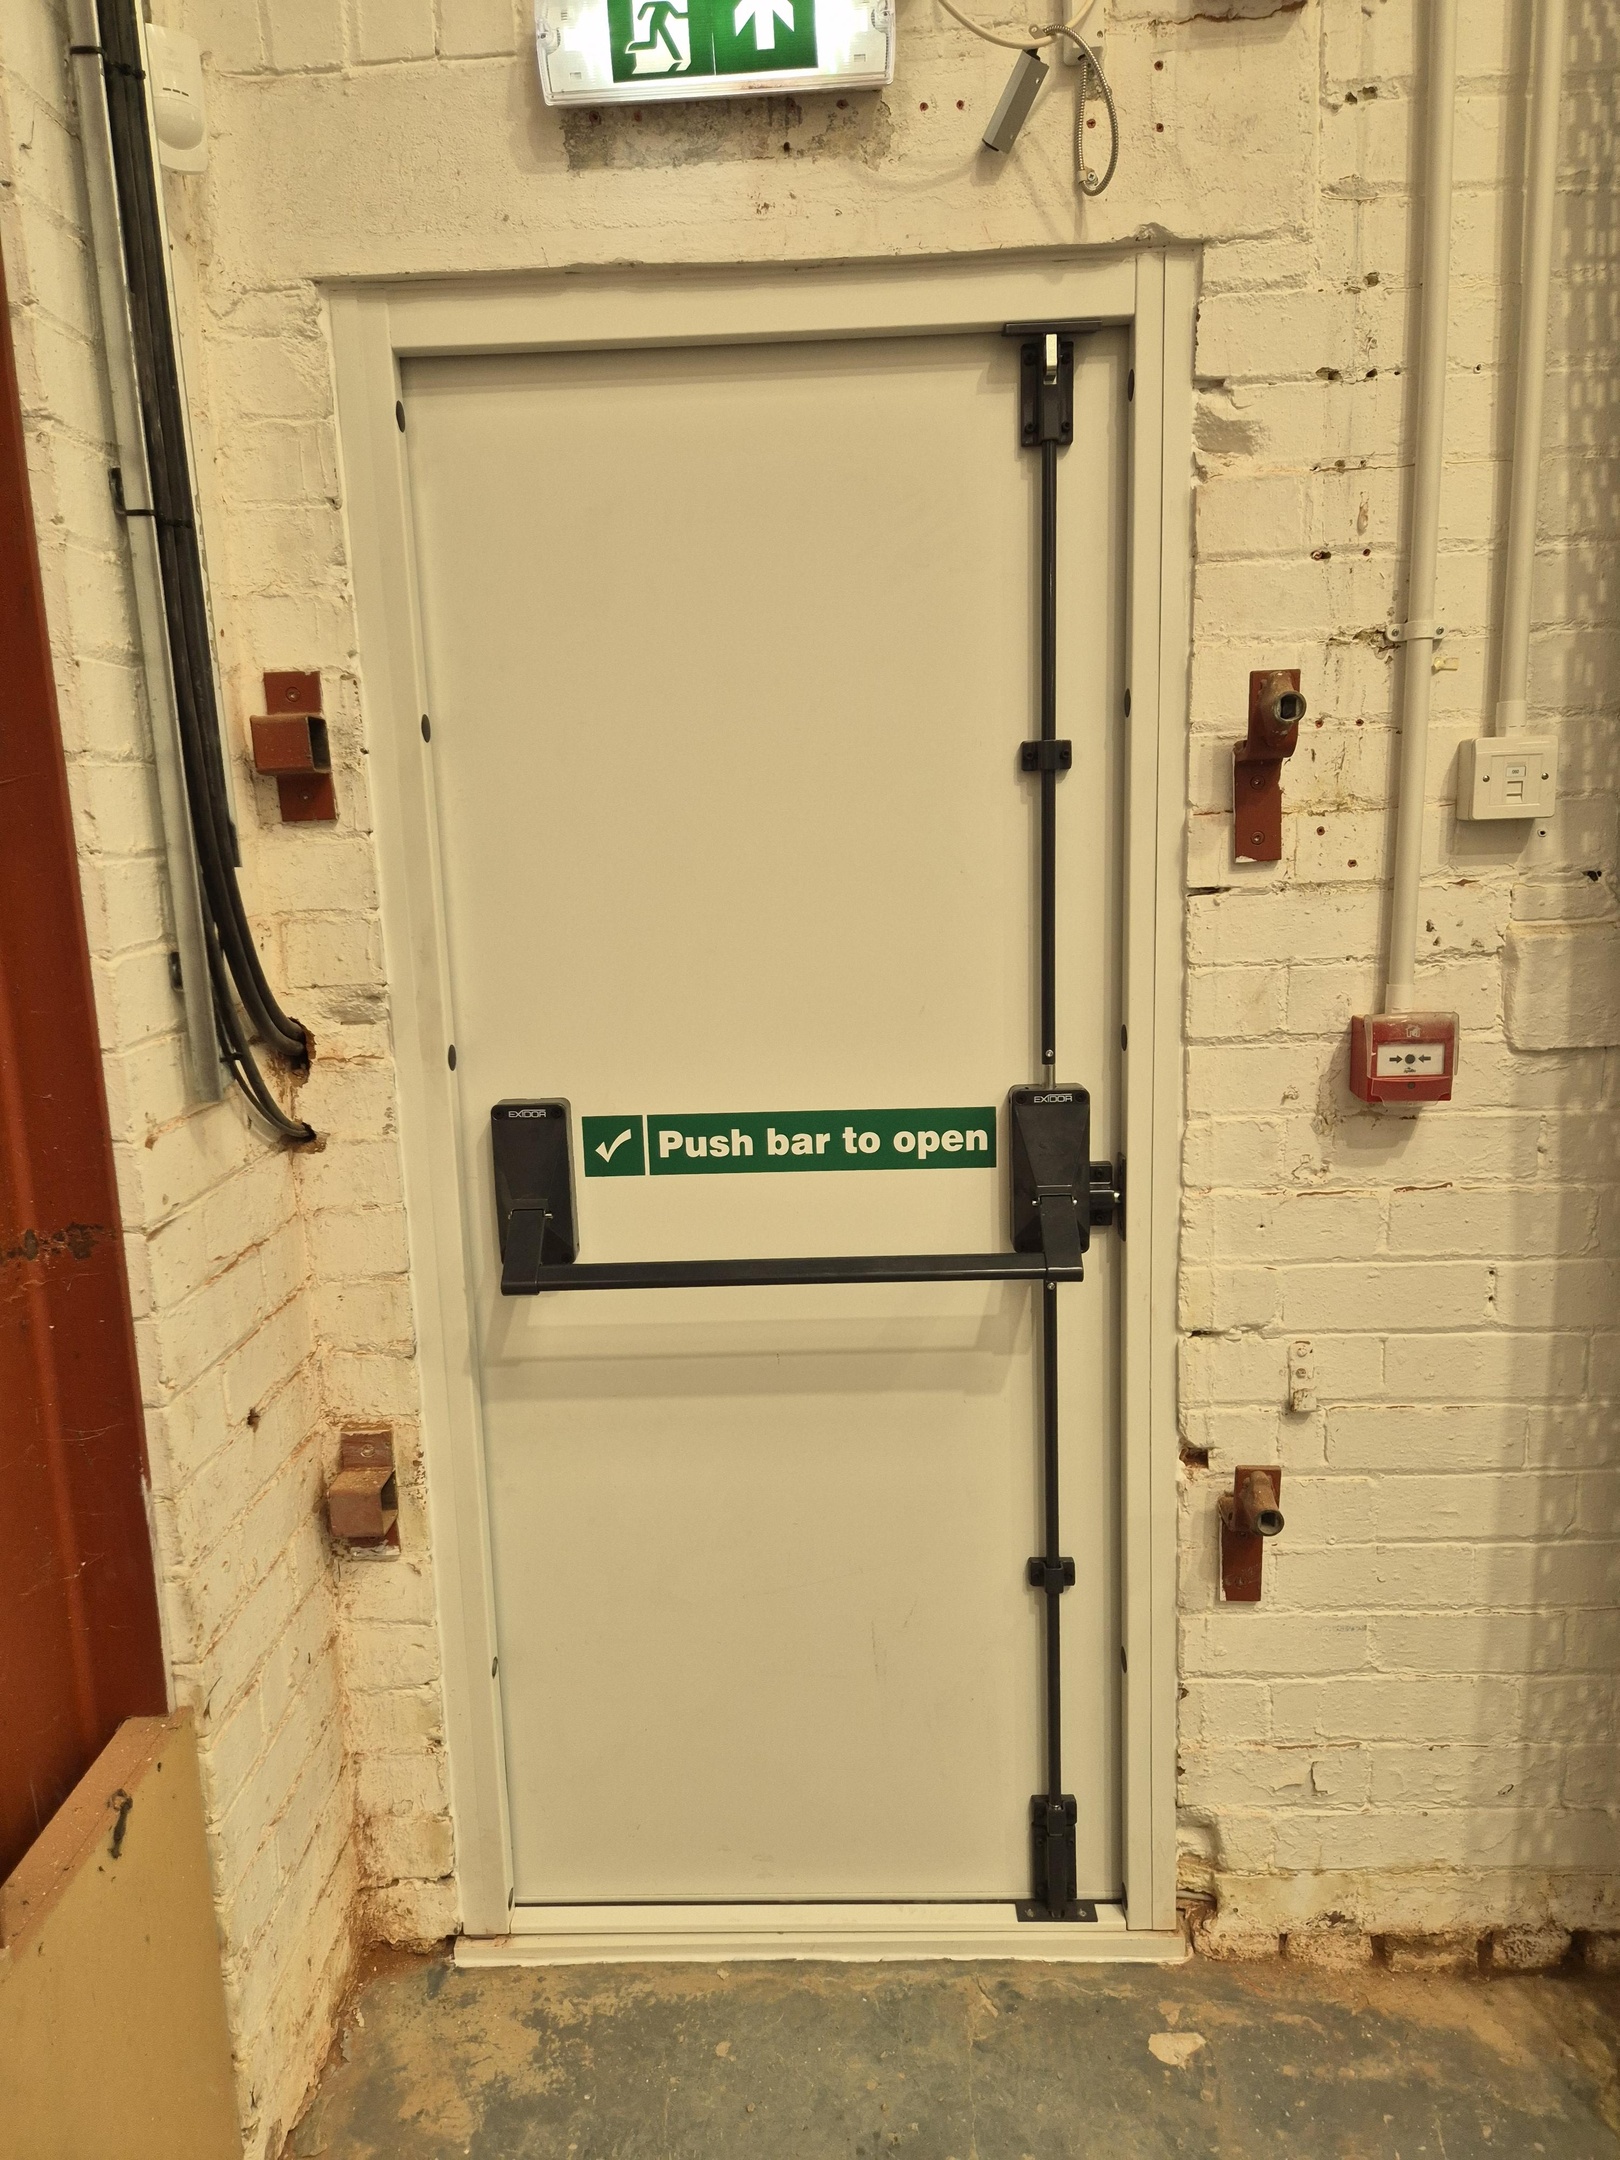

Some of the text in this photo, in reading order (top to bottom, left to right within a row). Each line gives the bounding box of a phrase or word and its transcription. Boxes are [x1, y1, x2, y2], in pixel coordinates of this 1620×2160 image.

[1033, 1093, 1073, 1103] EXIDOR
[508, 1108, 547, 1118] EXIDOR
[658, 1126, 988, 1160] Push bar to open
